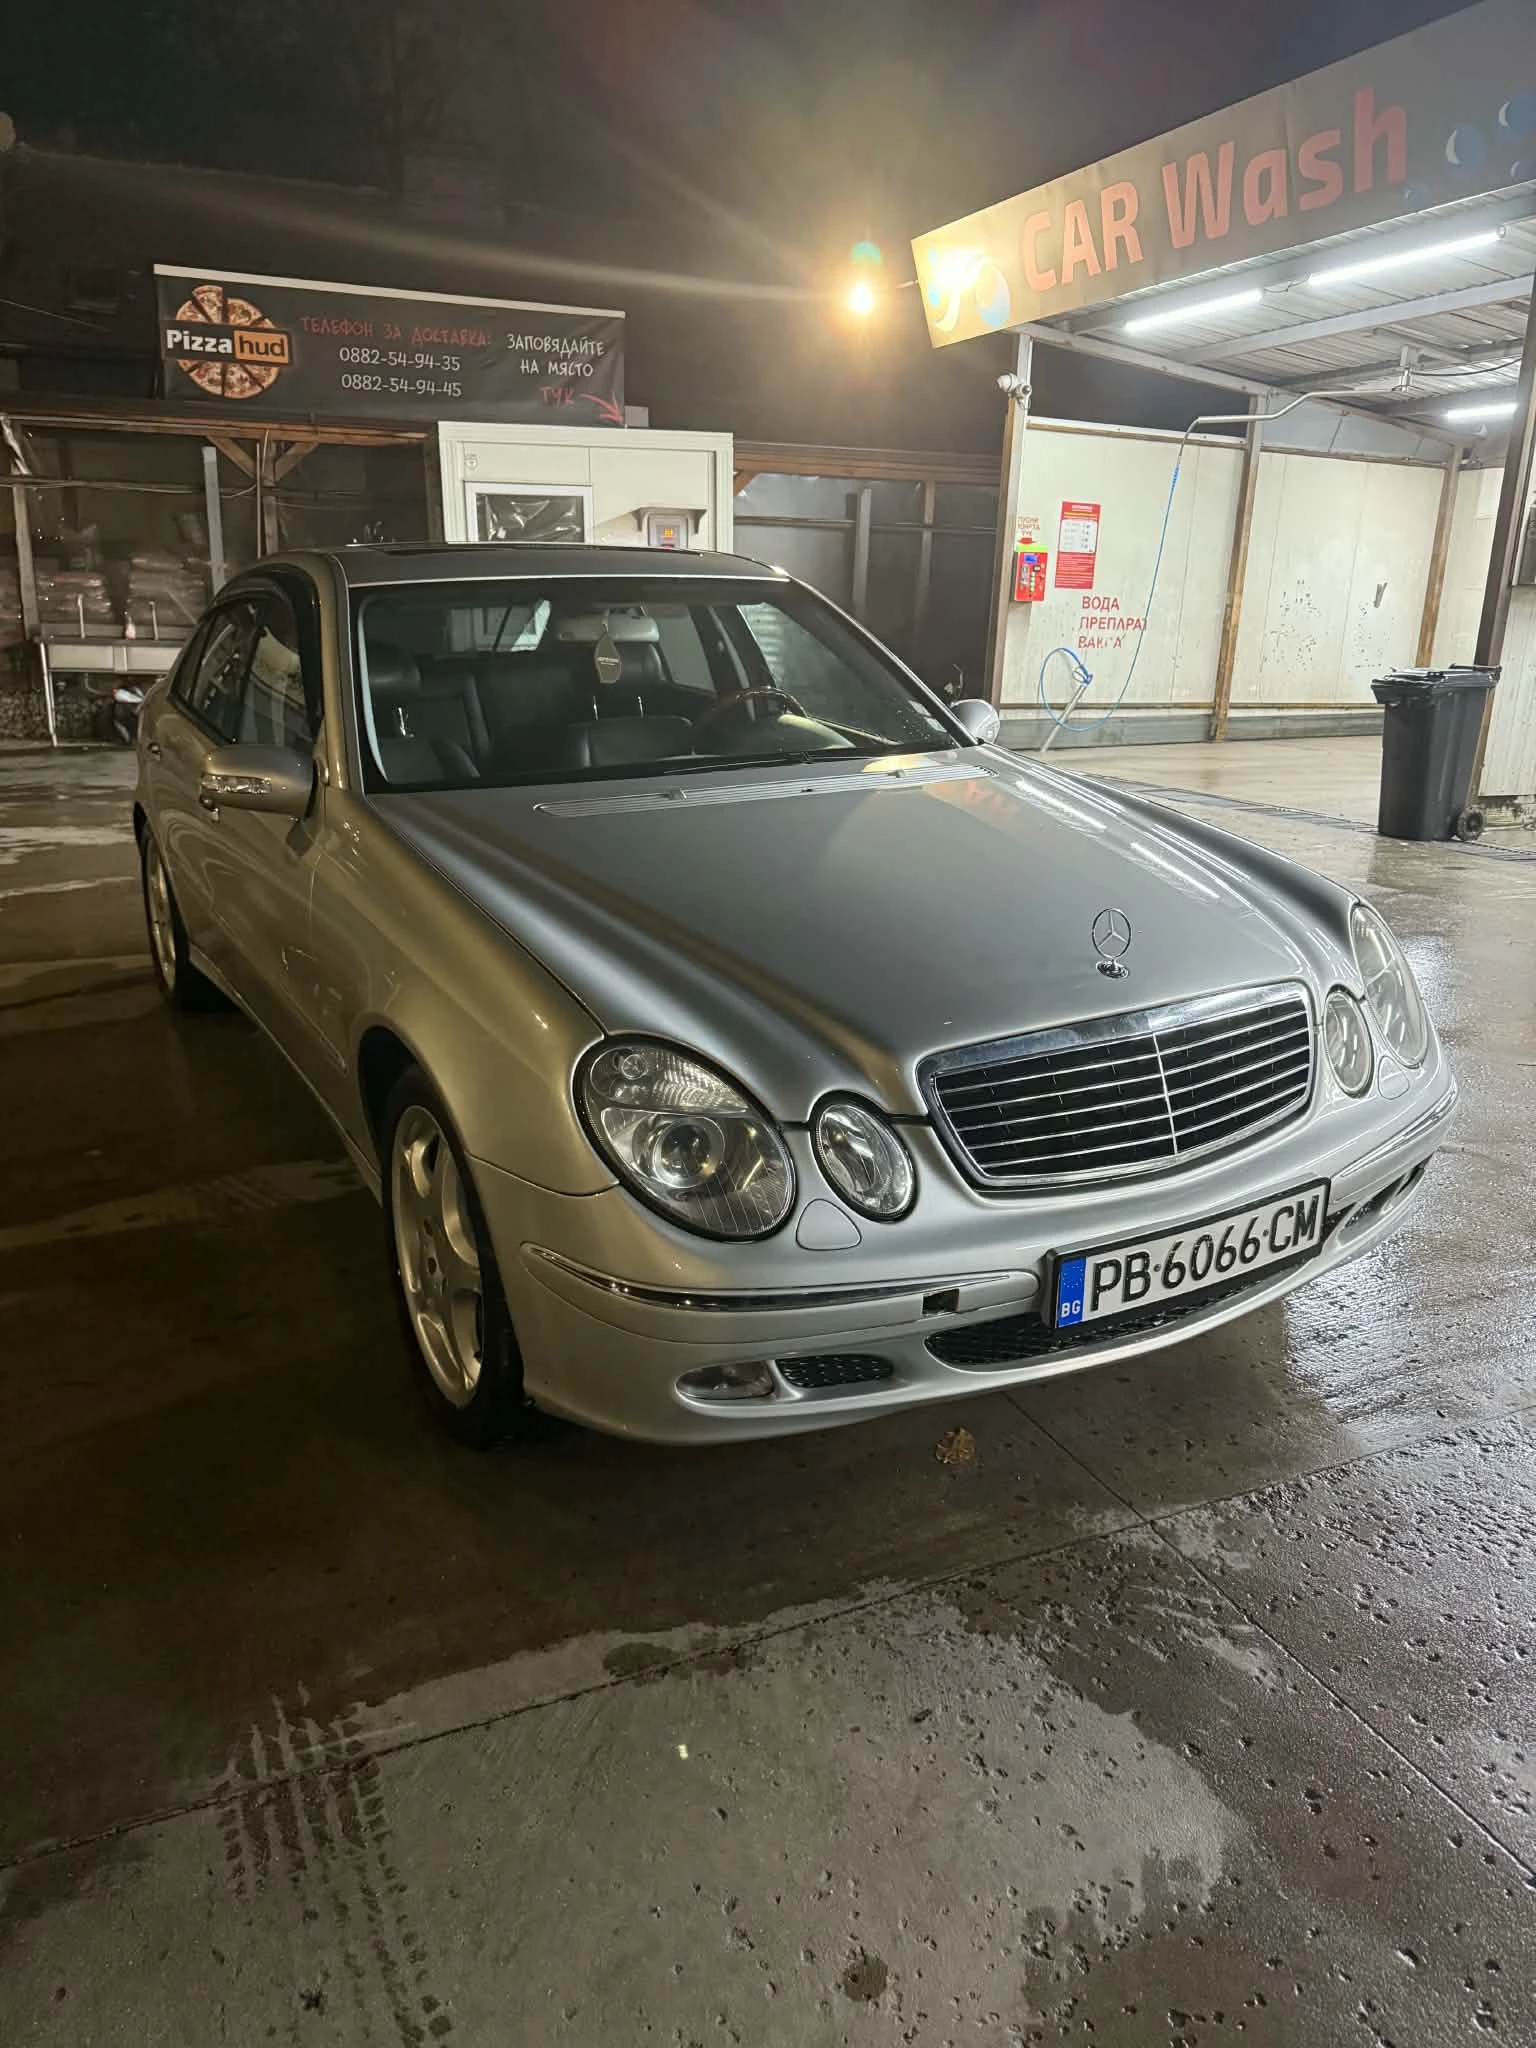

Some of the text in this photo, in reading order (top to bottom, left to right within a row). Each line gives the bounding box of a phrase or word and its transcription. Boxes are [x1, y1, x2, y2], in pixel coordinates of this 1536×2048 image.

[1021, 87, 1408, 292] CAR Wash
[301, 316, 373, 337] ТЕЛЕФОН
[383, 323, 401, 340] ЗА
[166, 329, 285, 357] Pizza hud
[506, 333, 605, 359] ЗАПОВЯДАЙТЕ
[339, 347, 461, 371] 0882-54-94-35
[520, 359, 594, 377] НА МЯСТО
[341, 374, 462, 397] 0882-54-94-45
[540, 386, 575, 408] ТУК
[1082, 596, 1120, 612] ВОДА
[1061, 1300, 1081, 1318] BG
